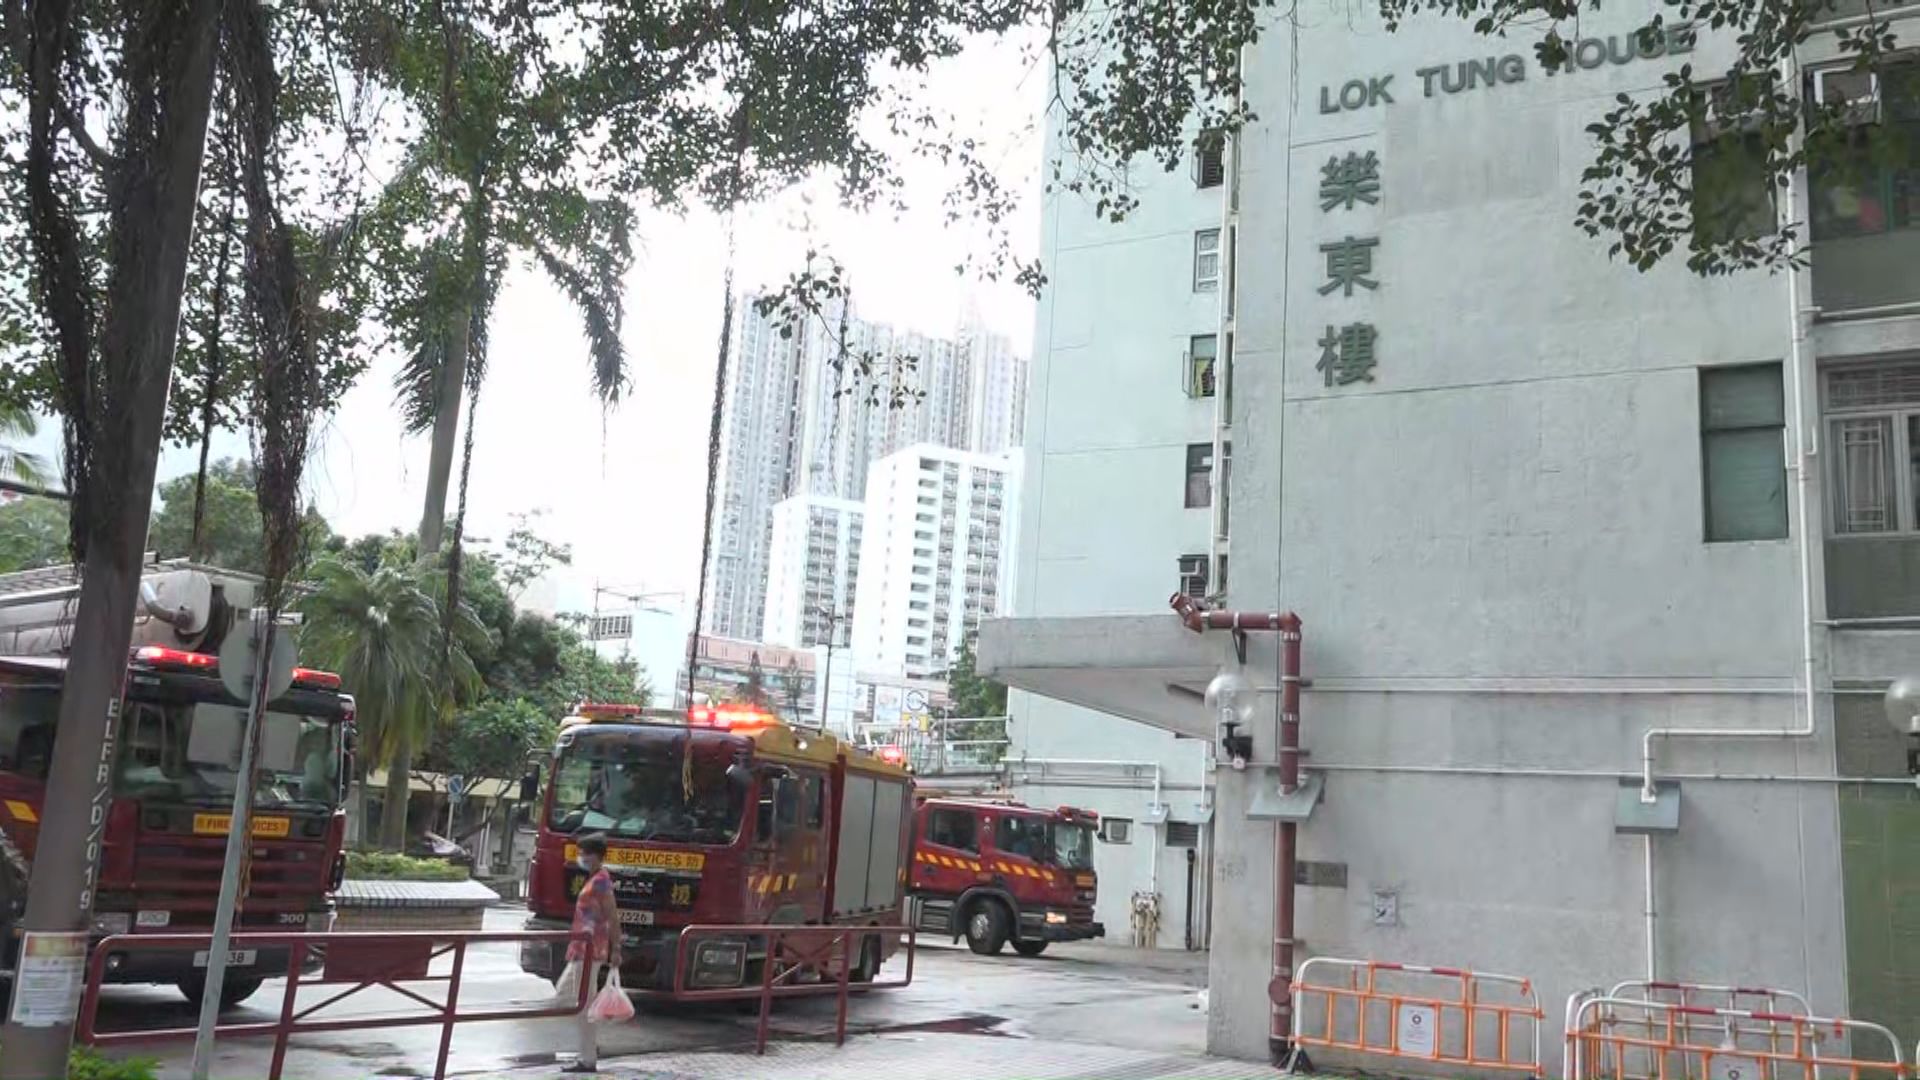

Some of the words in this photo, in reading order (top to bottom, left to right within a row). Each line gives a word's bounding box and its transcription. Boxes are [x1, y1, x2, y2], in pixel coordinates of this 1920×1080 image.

[1319, 74, 1395, 115] LOK
[1415, 54, 1526, 97] TUNG
[1315, 150, 1381, 388] 樂東樓
[616, 850, 682, 865] SERVICES
[279, 914, 305, 924] 300
